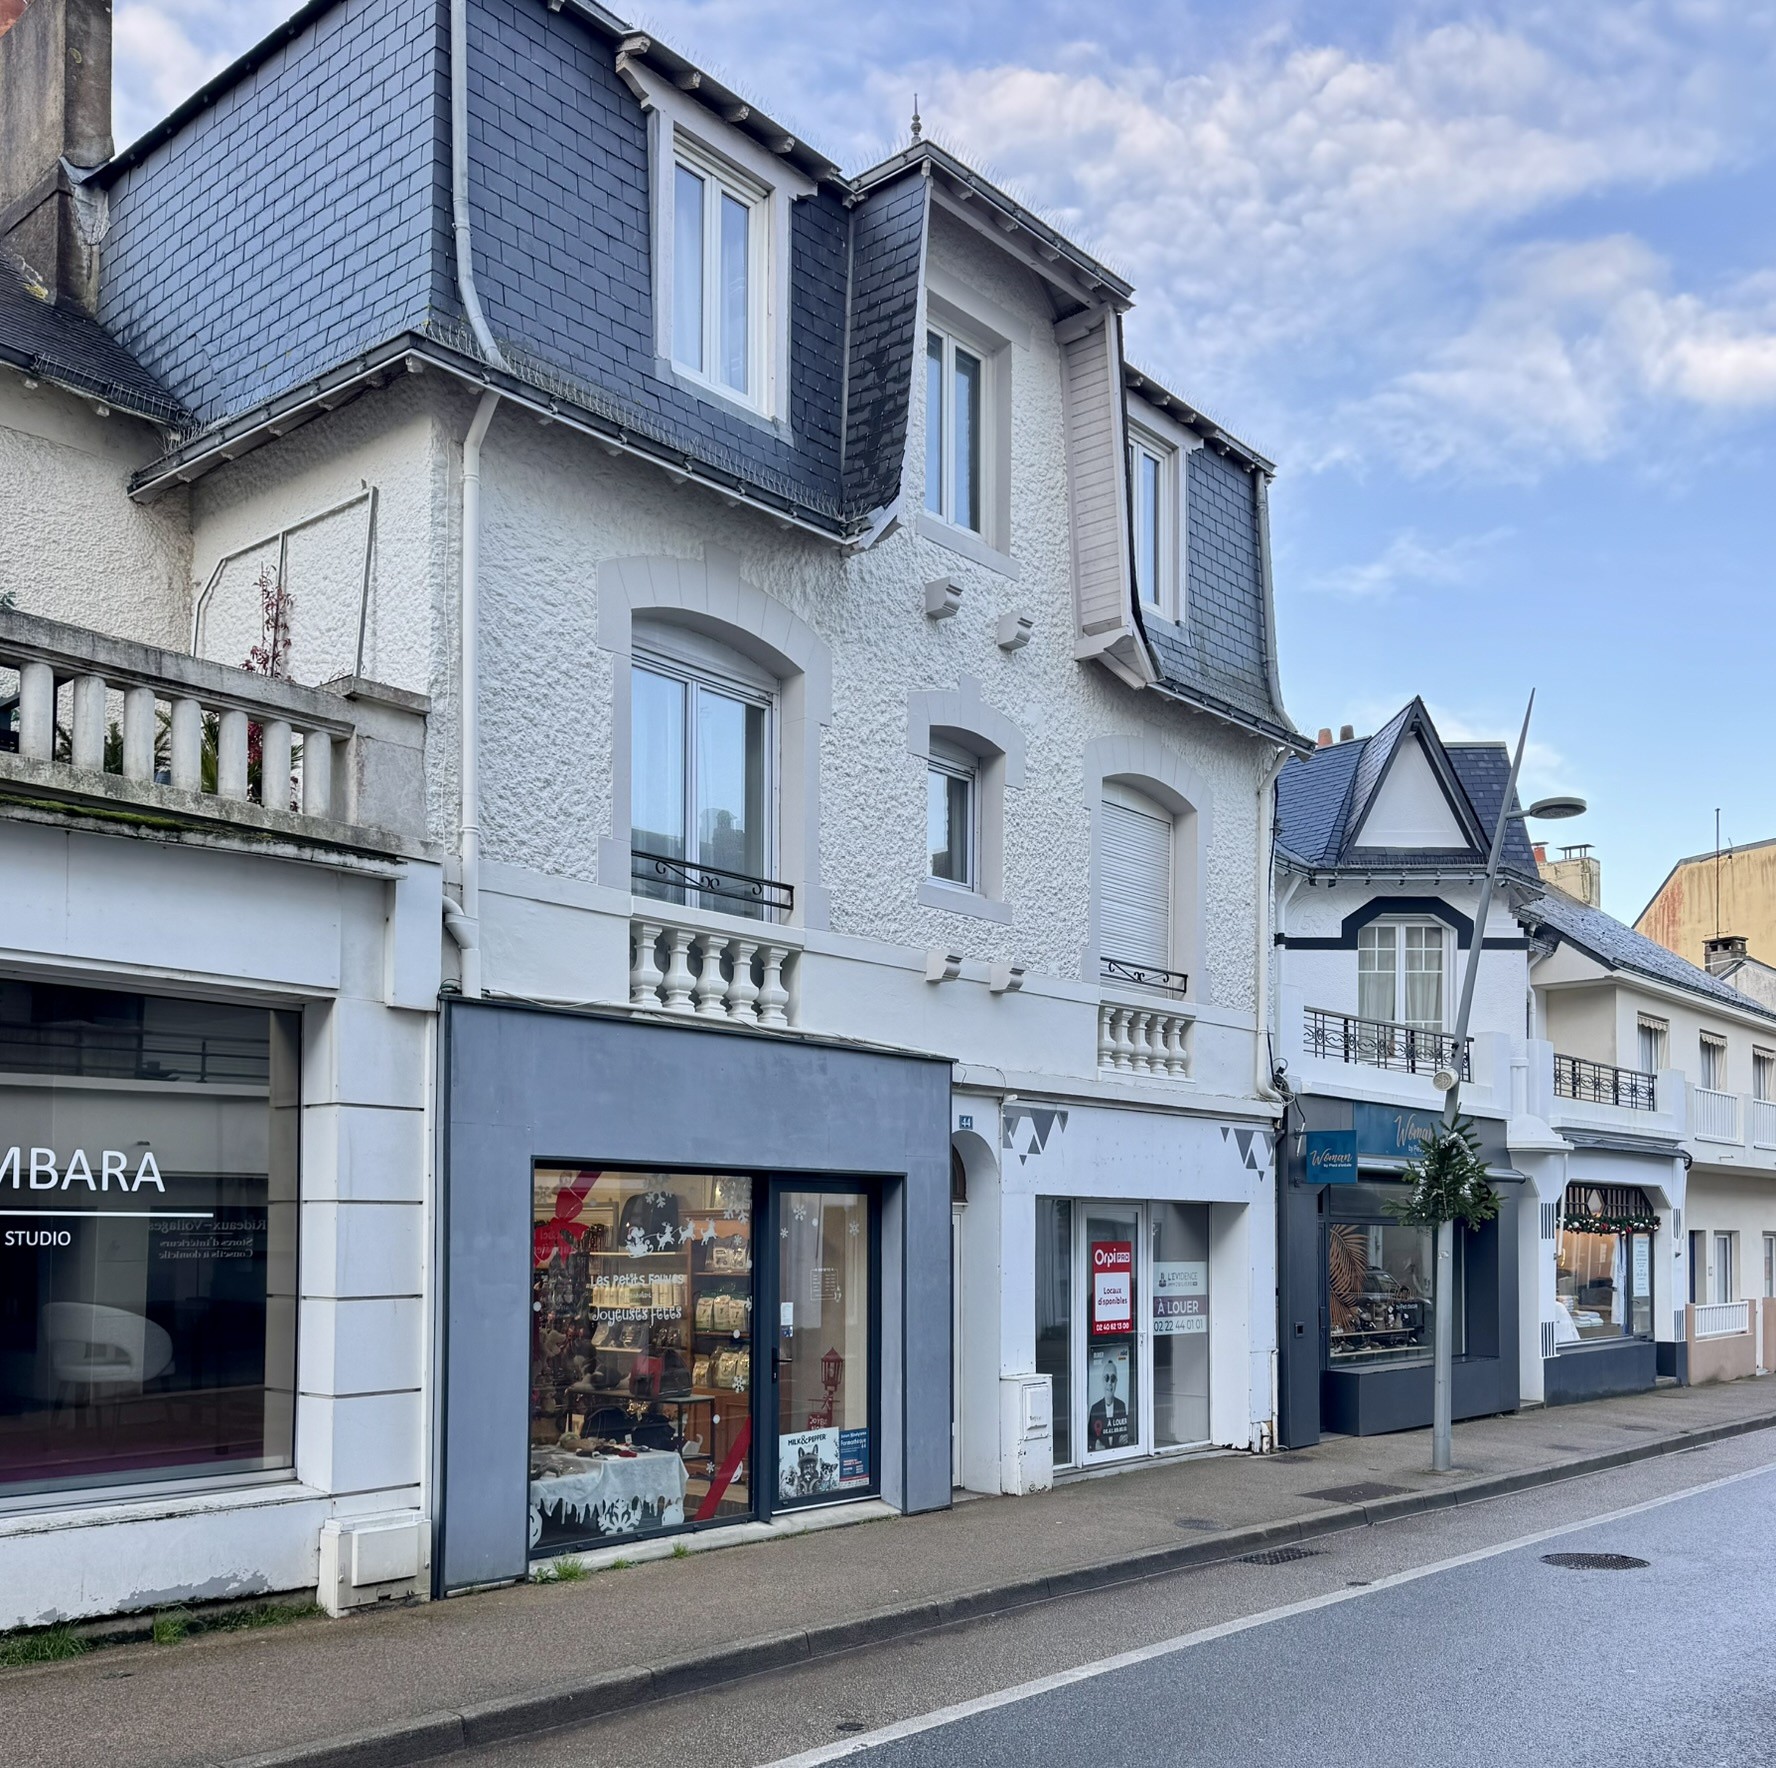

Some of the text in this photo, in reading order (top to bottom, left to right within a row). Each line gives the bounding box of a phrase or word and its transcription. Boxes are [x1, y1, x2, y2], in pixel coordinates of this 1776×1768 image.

[961, 1117, 971, 1128] 44
[1310, 1148, 1352, 1166] Woman
[5, 1230, 71, 1246] STUDIO
[1095, 1248, 1130, 1268] Orpi PRO
[590, 1272, 684, 1287] Les Petits Fauves
[1103, 1287, 1122, 1295] Locaux
[1098, 1296, 1128, 1307] disponibles
[1157, 1298, 1199, 1315] À LOUER
[592, 1305, 648, 1327] Joyeuses
[1096, 1323, 1103, 1331] 02
[1103, 1322, 1110, 1331] 40
[1154, 1318, 1204, 1332] 02 22 44 01 01
